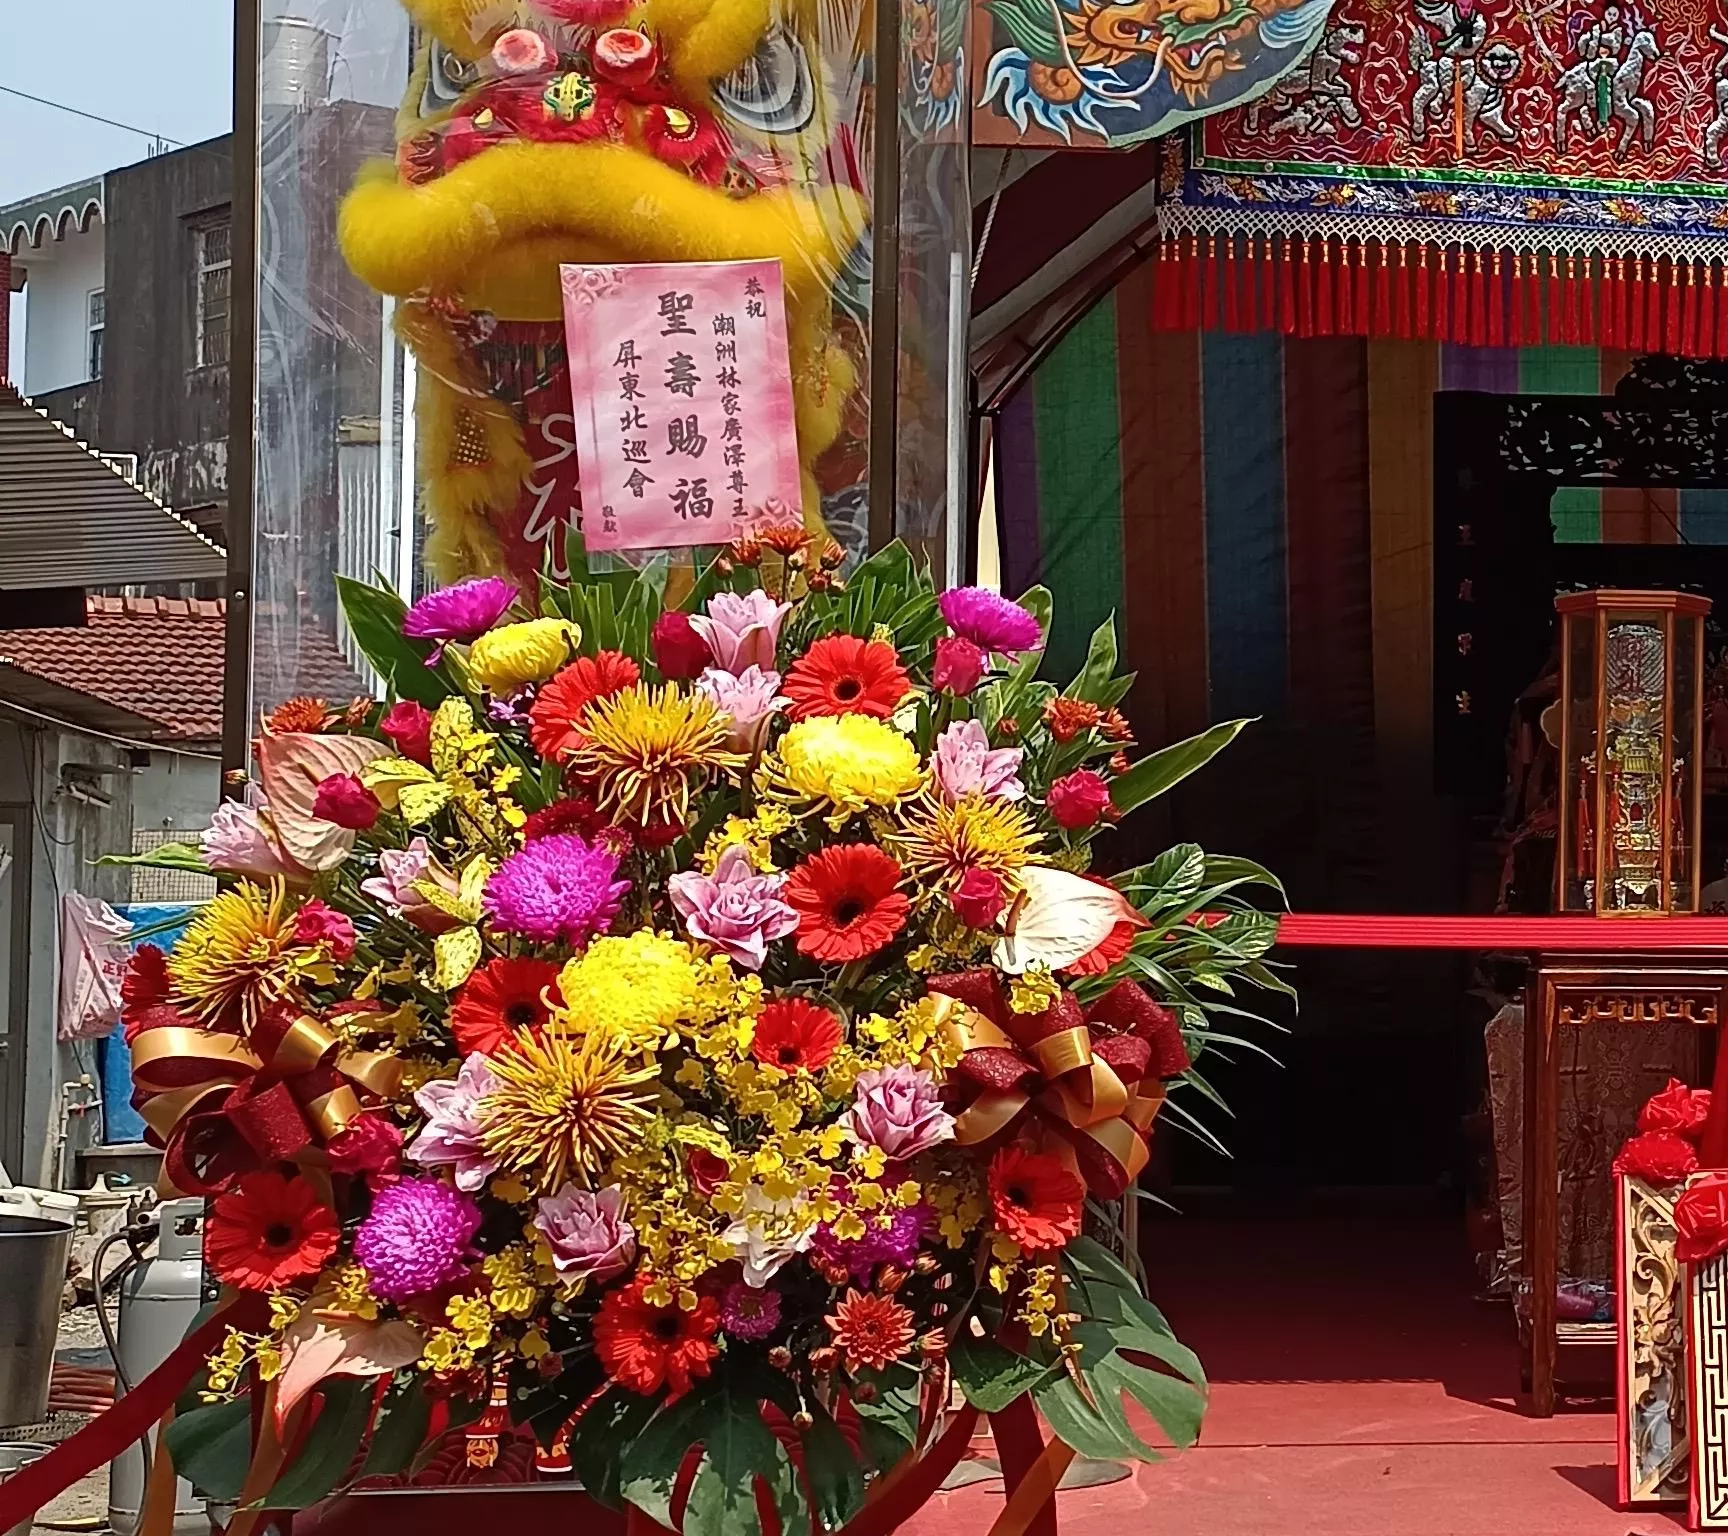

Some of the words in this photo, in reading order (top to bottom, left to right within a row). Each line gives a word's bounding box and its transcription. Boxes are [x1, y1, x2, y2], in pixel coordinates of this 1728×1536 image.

[743, 276, 767, 319] 恭祝
[613, 339, 655, 498] 屏東北巡會
[657, 290, 714, 520] 聖壽賜福
[712, 313, 748, 517] 潮洲林家廣澤尊王
